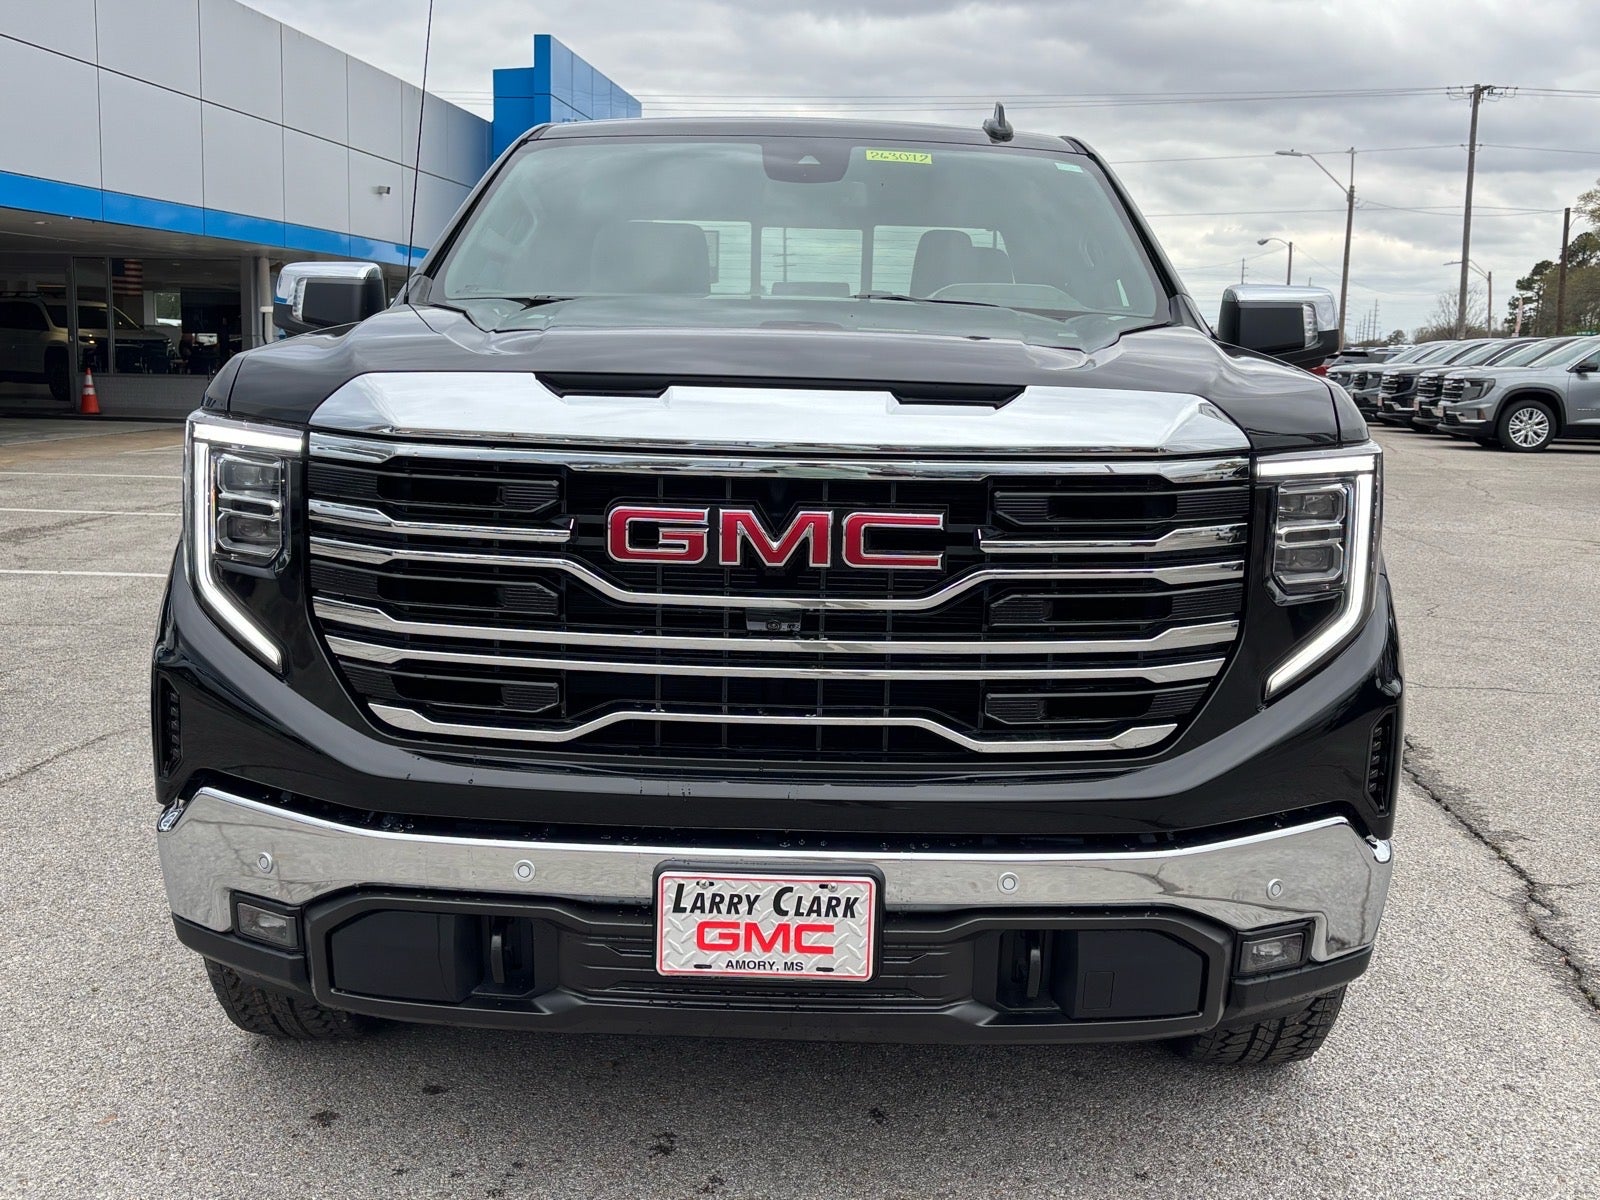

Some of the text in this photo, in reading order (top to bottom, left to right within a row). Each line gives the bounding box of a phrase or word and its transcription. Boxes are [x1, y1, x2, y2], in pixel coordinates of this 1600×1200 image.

[608, 506, 945, 570] GMC
[672, 883, 860, 918] LARRY CLARK
[696, 921, 834, 954] GMC
[725, 960, 804, 972] AMORY, MS
